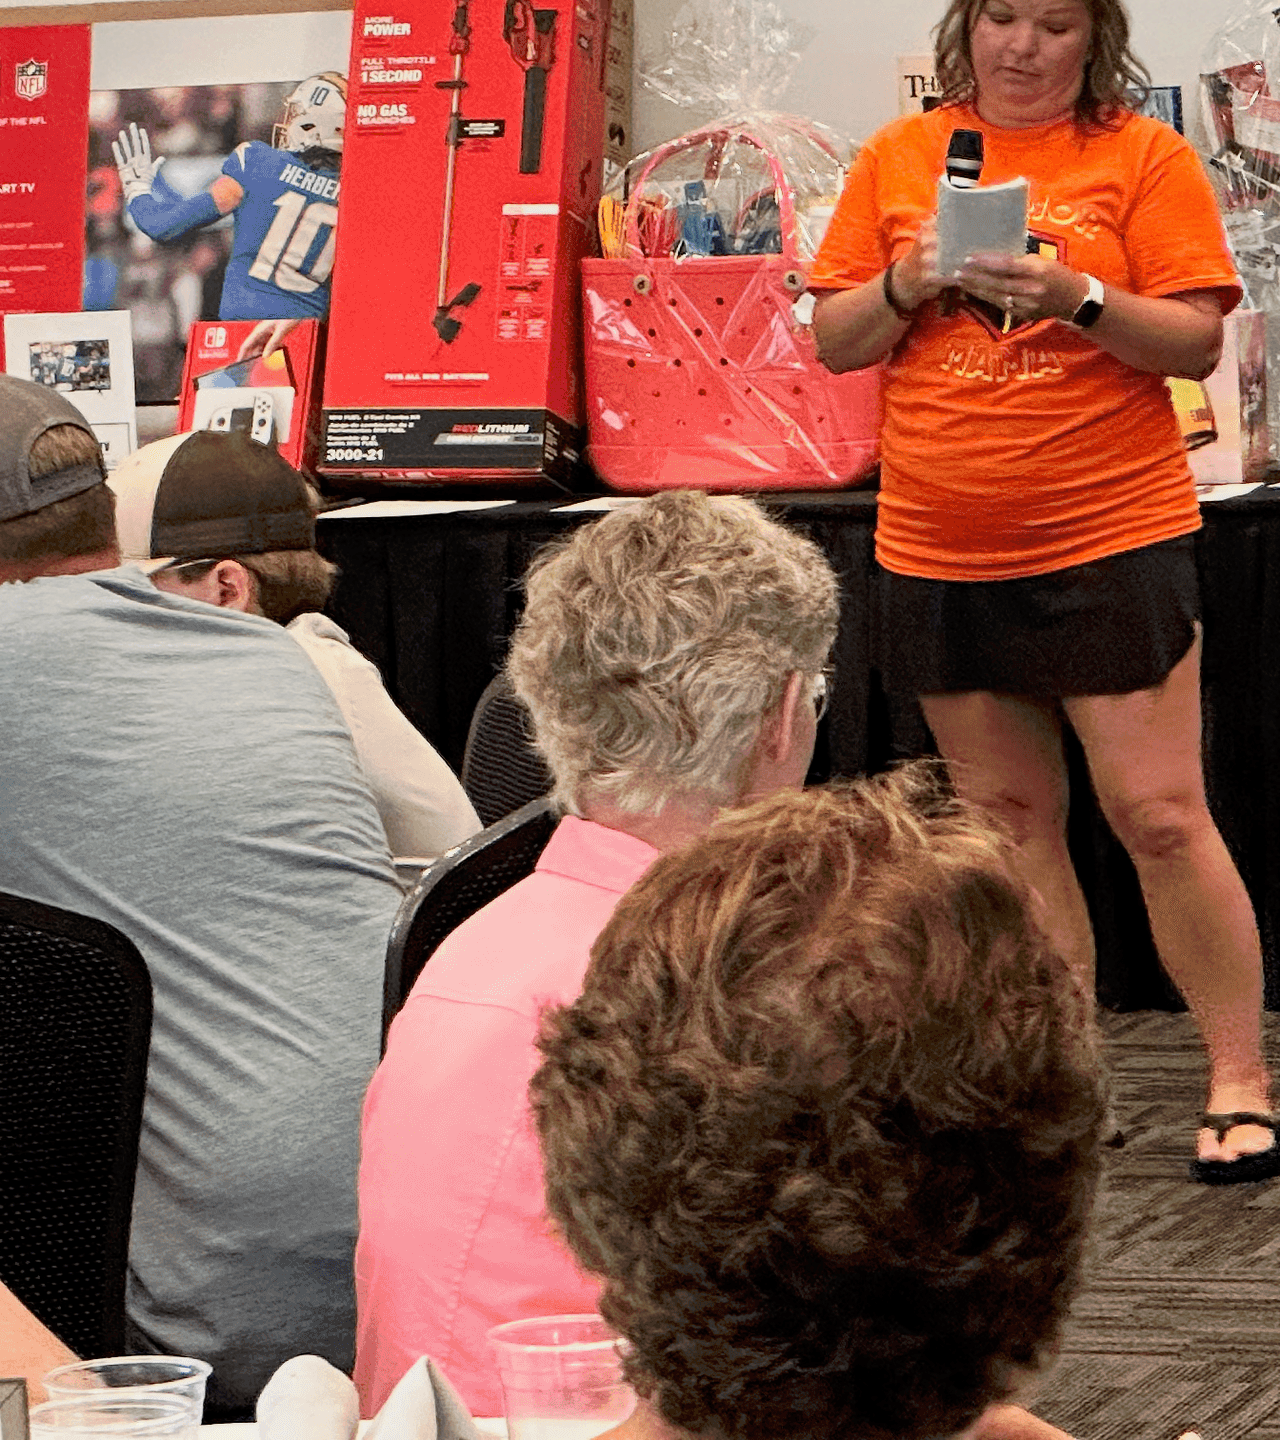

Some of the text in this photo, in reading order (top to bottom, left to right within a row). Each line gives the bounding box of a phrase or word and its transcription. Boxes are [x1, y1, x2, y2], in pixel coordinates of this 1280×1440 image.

[363, 23, 411, 36] POWER
[20, 77, 44, 94] NFL
[310, 86, 329, 106] 10
[357, 104, 407, 117] NO GAS
[19, 182, 35, 194] TV
[247, 190, 339, 294] 10
[325, 448, 384, 461] 3000-21
